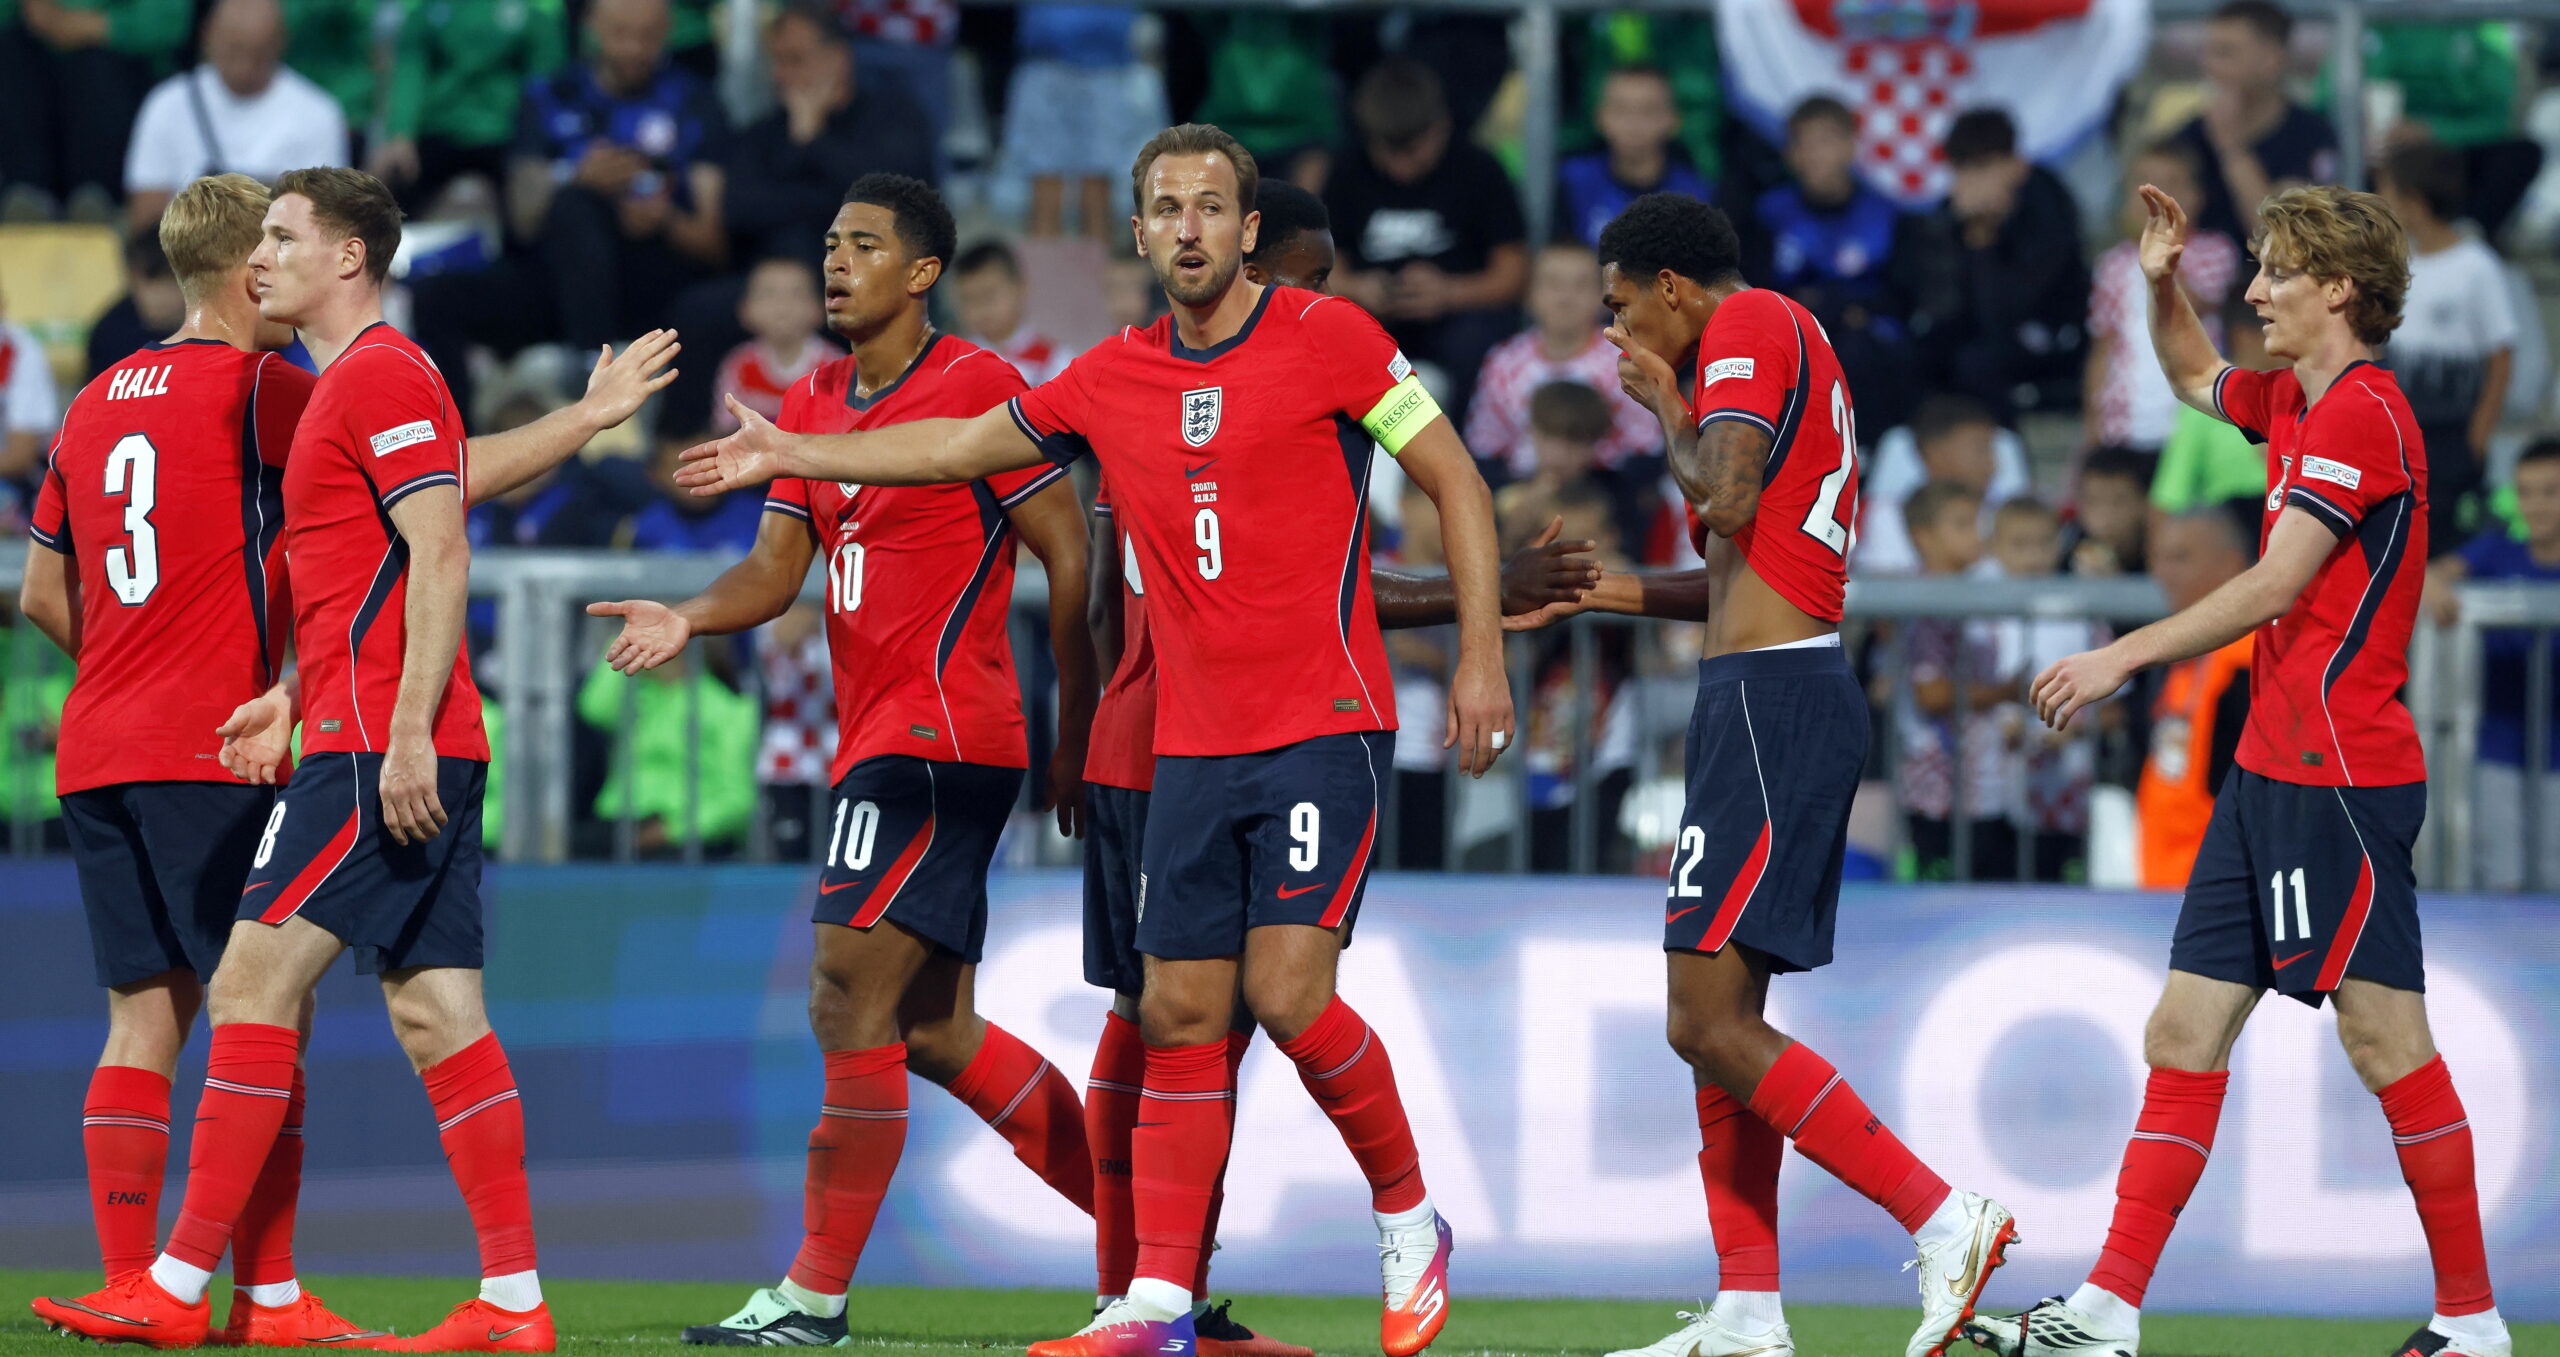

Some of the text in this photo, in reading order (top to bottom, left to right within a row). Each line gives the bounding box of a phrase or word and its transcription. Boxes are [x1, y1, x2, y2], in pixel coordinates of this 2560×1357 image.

[107, 364, 173, 401] HALL
[1382, 392, 1421, 429] RESPECT
[373, 426, 433, 450] FOUNDATION
[2303, 461, 2358, 483] FOUNDATION
[103, 432, 159, 606] 3
[1191, 482, 1218, 493] CROATIA
[829, 542, 865, 614] 10
[1194, 507, 1223, 581] 9
[254, 801, 287, 869] 8
[827, 798, 880, 871] 10
[1289, 802, 1320, 872] 9
[2271, 868, 2311, 942] 11
[107, 1191, 148, 1206] ENG
